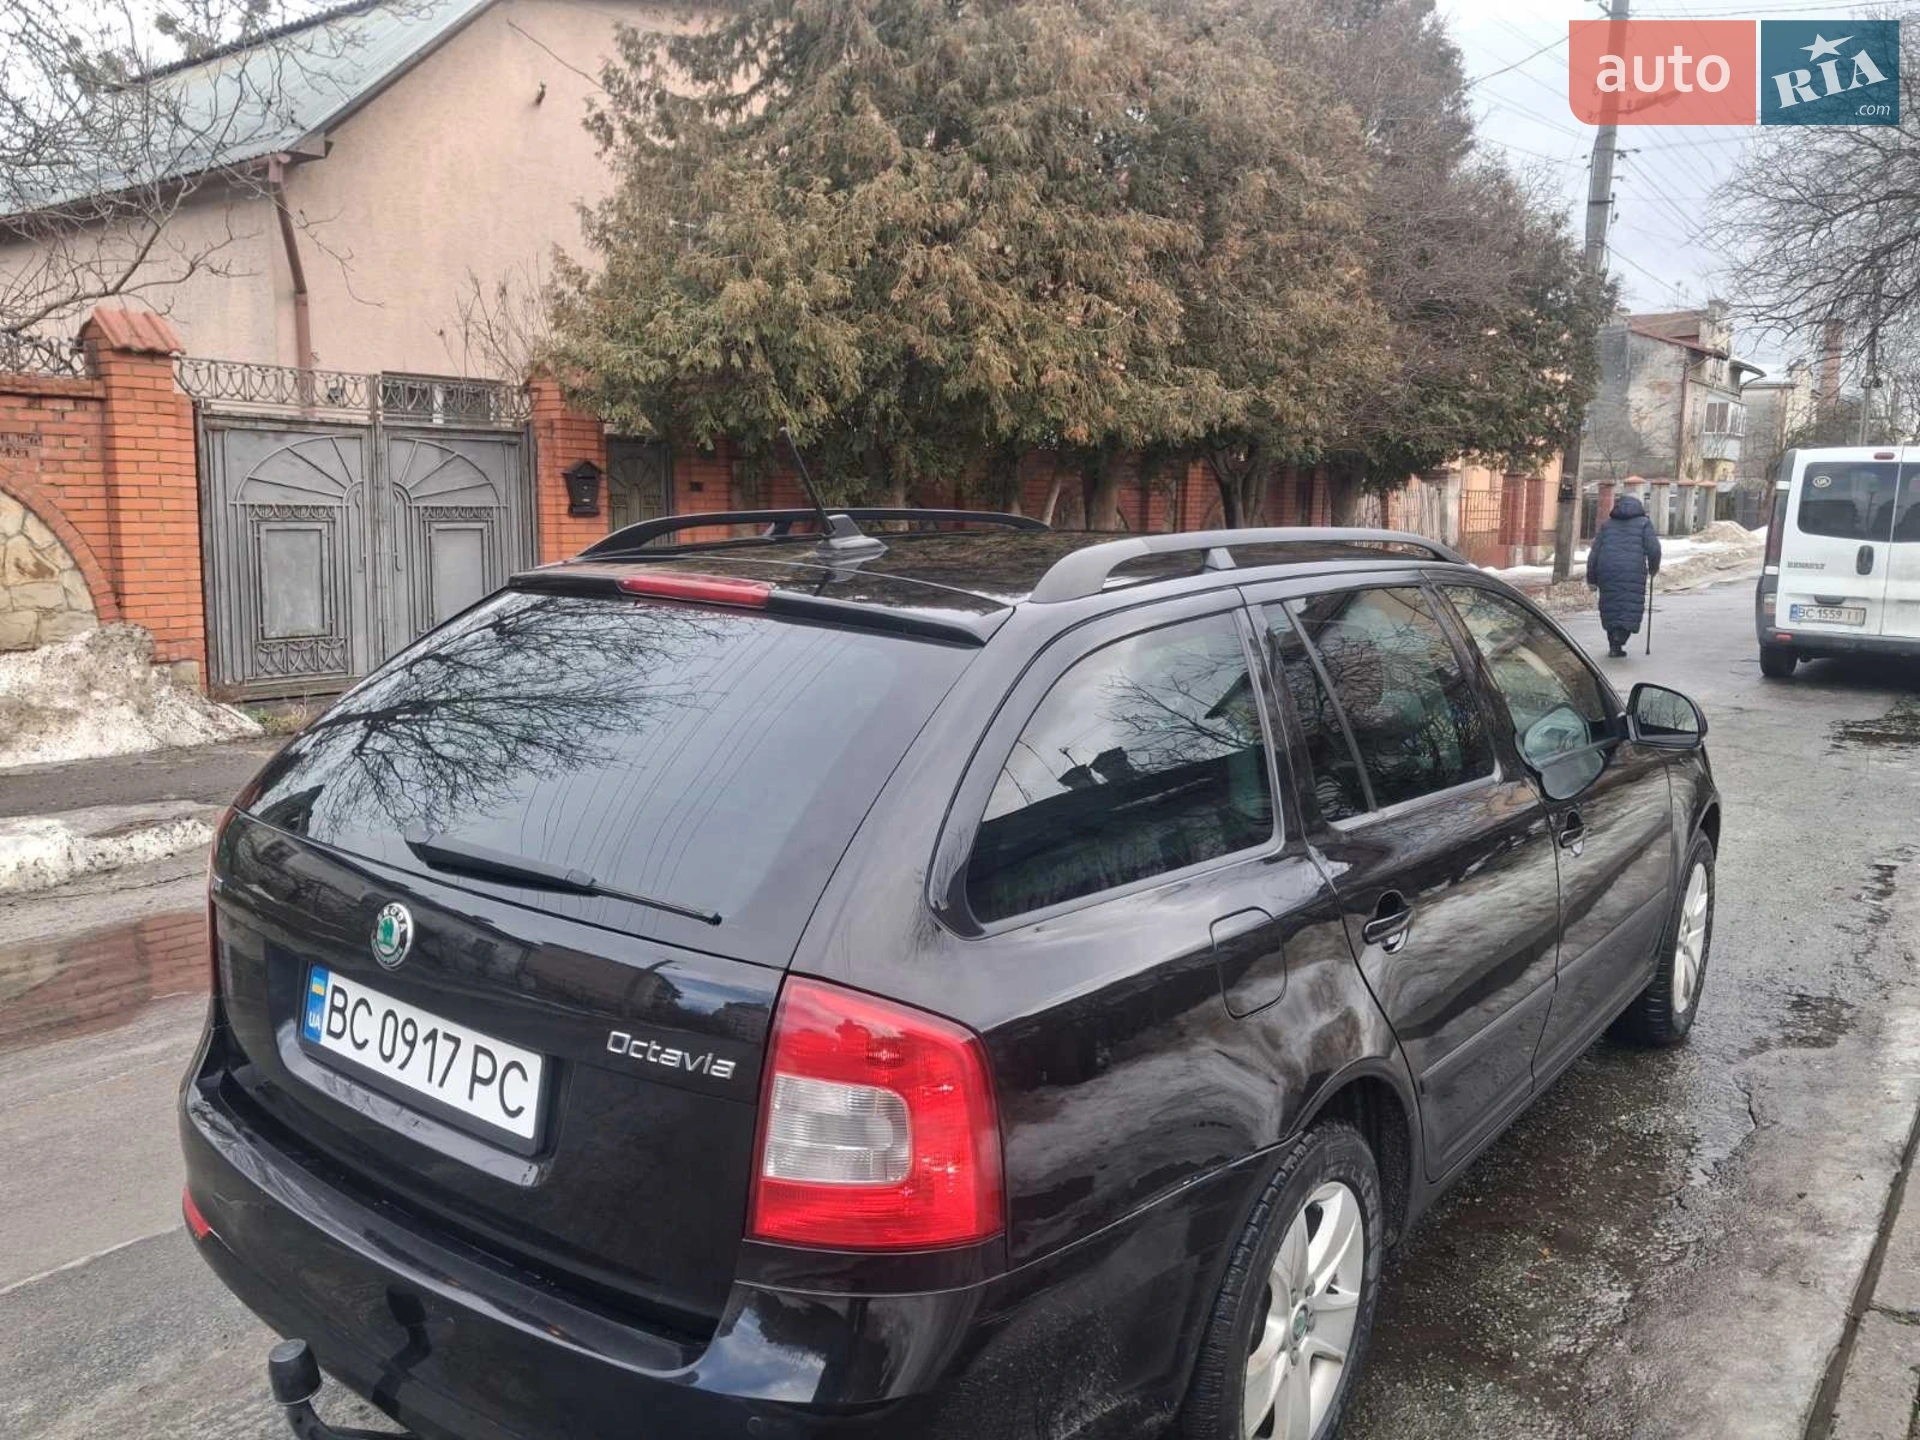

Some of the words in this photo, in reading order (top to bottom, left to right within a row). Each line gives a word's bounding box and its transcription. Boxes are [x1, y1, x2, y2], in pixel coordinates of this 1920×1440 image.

[1817, 608, 1843, 619] 1559
[308, 1010, 321, 1031] UA
[326, 984, 373, 1051] BC
[379, 1008, 462, 1089] 0917
[468, 1043, 529, 1119] PC
[606, 1031, 737, 1079] Octavia
